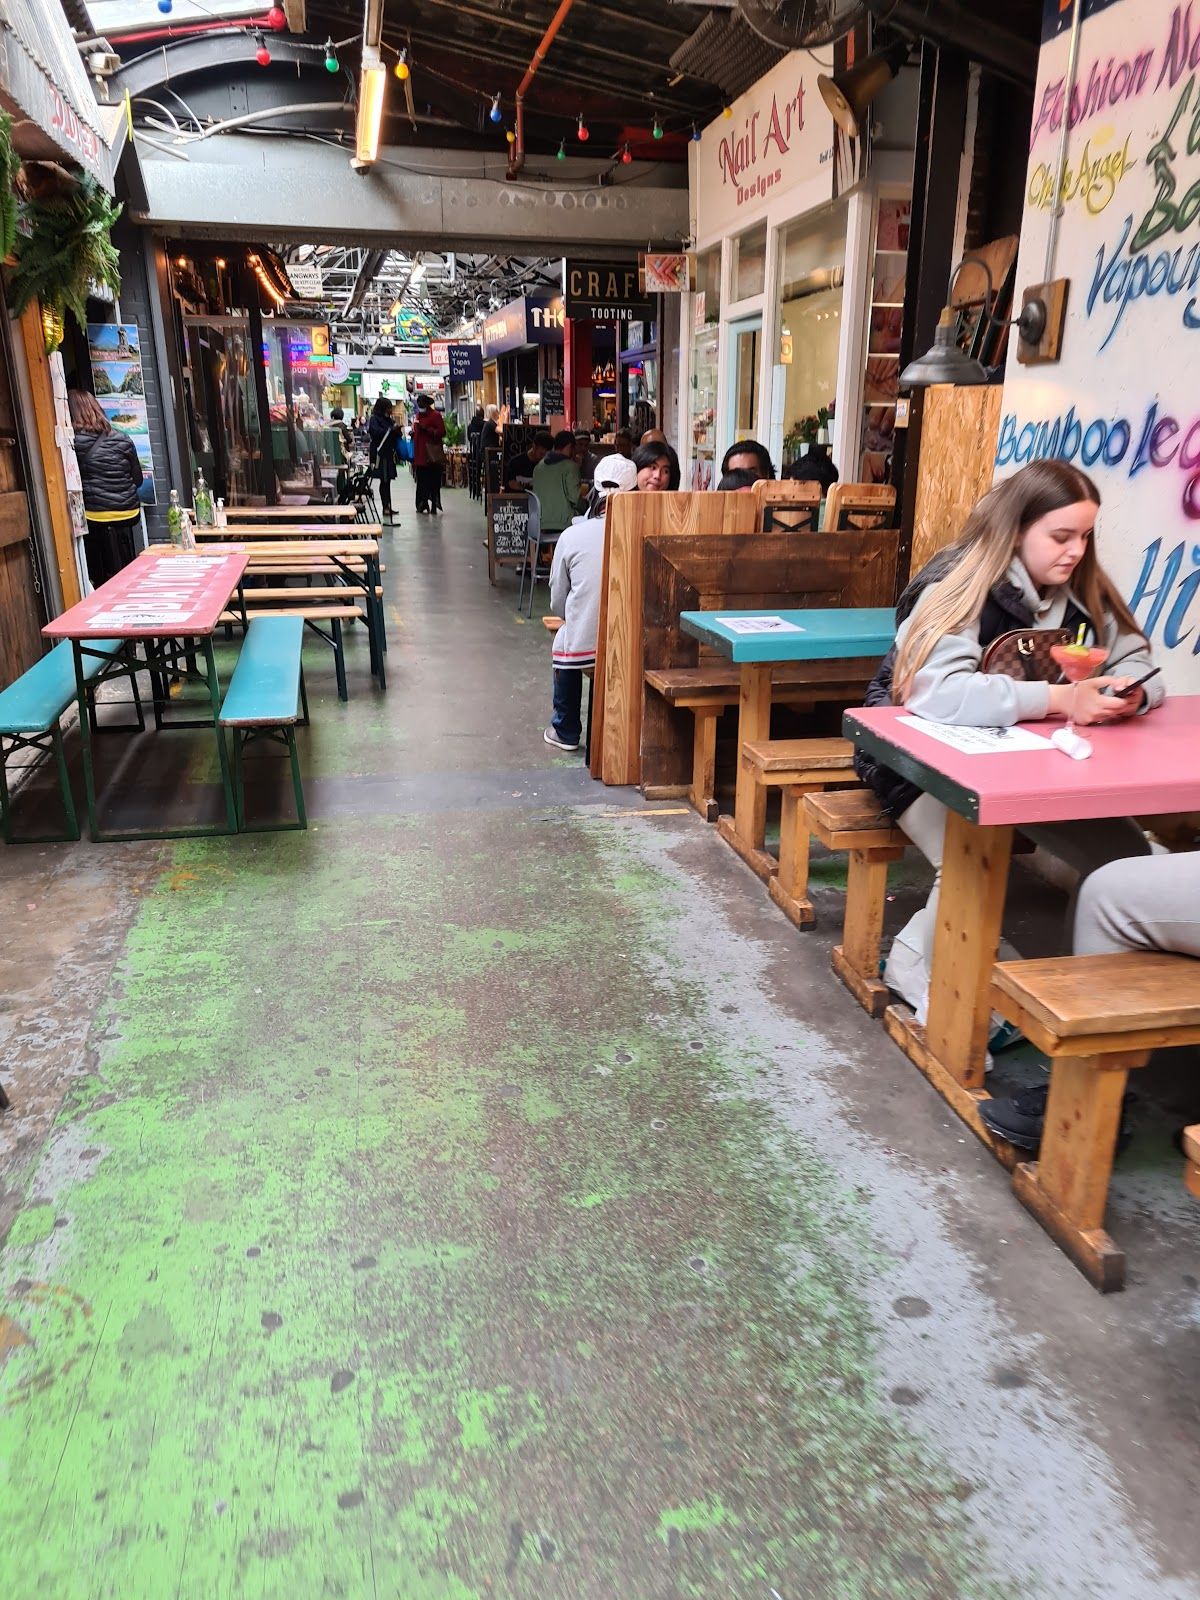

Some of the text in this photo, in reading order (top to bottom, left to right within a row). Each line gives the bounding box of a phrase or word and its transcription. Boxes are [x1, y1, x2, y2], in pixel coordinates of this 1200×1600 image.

[1029, 48, 1156, 152] Fashion
[718, 75, 806, 188] Nail Art
[736, 168, 783, 206] Designs
[1066, 130, 1138, 214] Angel
[570, 270, 649, 299] CRAF
[591, 307, 633, 320] TOOTING
[452, 358, 471, 366] Tapas
[995, 405, 1131, 466] Bamboo
